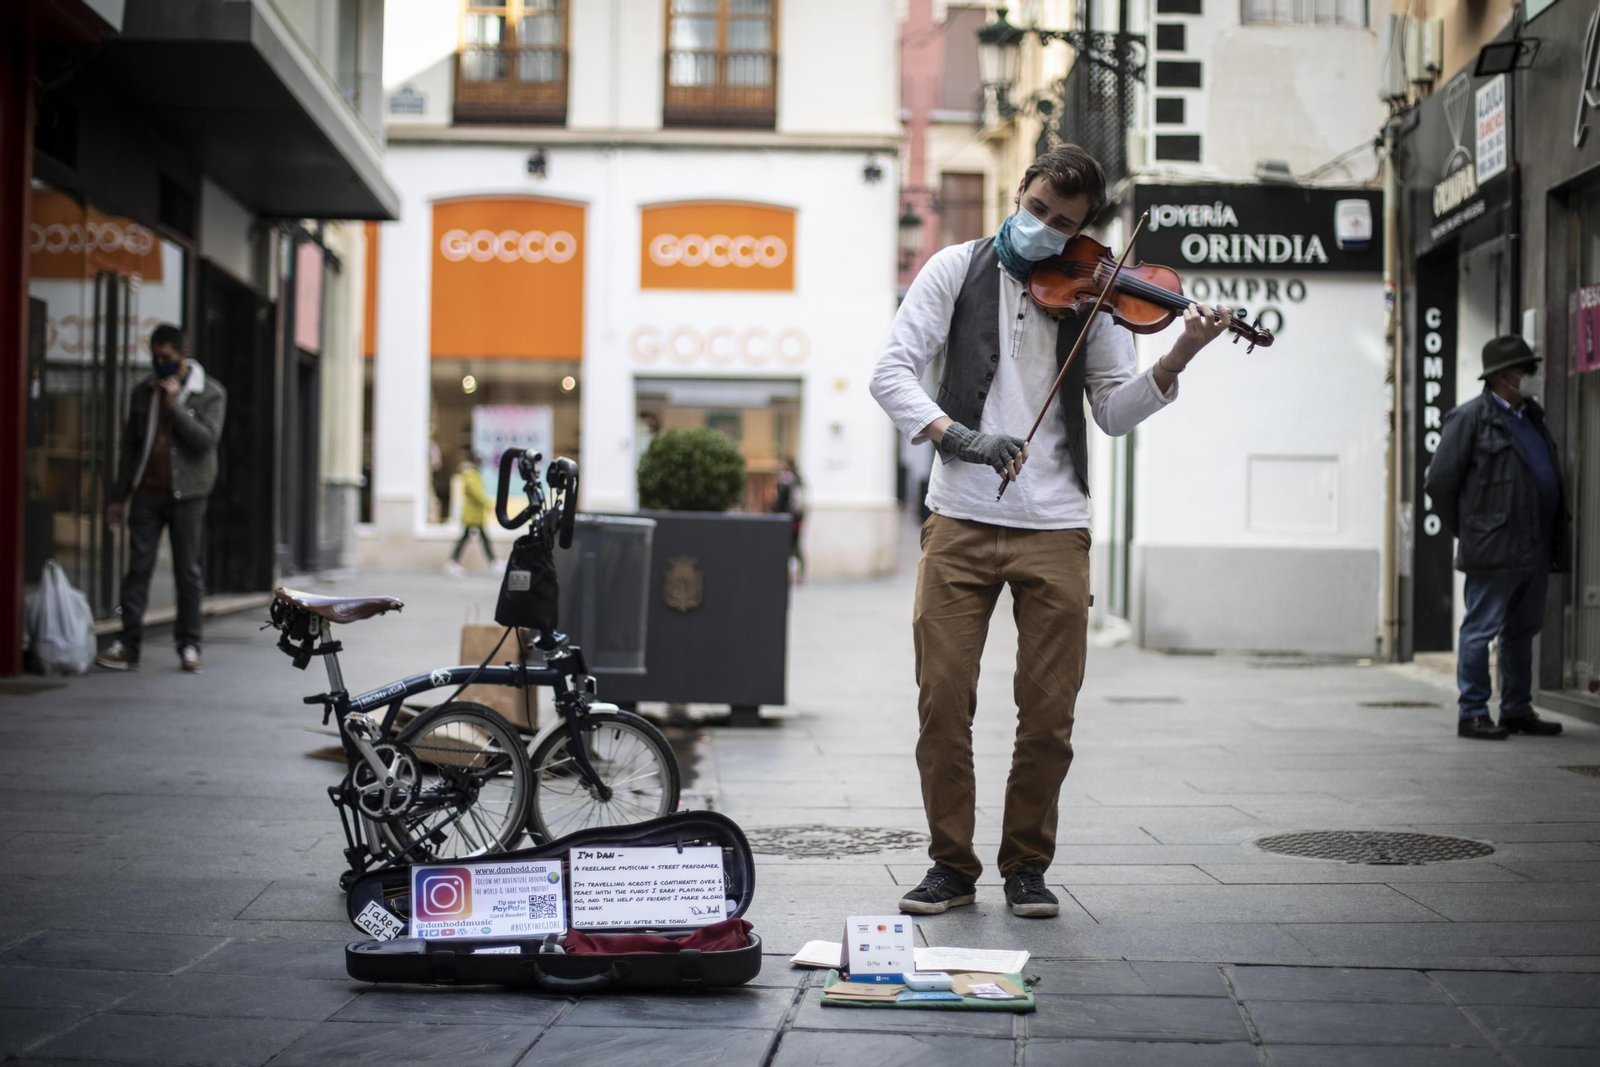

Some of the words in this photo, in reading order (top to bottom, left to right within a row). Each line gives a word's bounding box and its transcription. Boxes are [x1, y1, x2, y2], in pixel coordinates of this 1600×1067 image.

[1147, 200, 1239, 232] JOYERÍA
[440, 229, 577, 264] GOCCO
[648, 233, 788, 268] GOCCO
[1181, 233, 1329, 263] ORINDIA
[628, 324, 811, 367] GOCCO
[1423, 307, 1443, 454] COMPRO
[577, 851, 593, 860] I'M
[596, 851, 615, 859] DAN
[474, 866, 547, 875] www.danhodd.com
[475, 877, 492, 885] FOLLOW
[502, 876, 527, 884] ADVENTURE
[528, 875, 546, 883] AROUND
[483, 887, 498, 895] WORLD
[505, 886, 517, 894] SHARE
[368, 902, 393, 928] Take
[392, 926, 400, 935] a
[492, 905, 520, 913] PayPal
[357, 912, 385, 937] Card
[416, 918, 493, 929] @danhoddmusic
